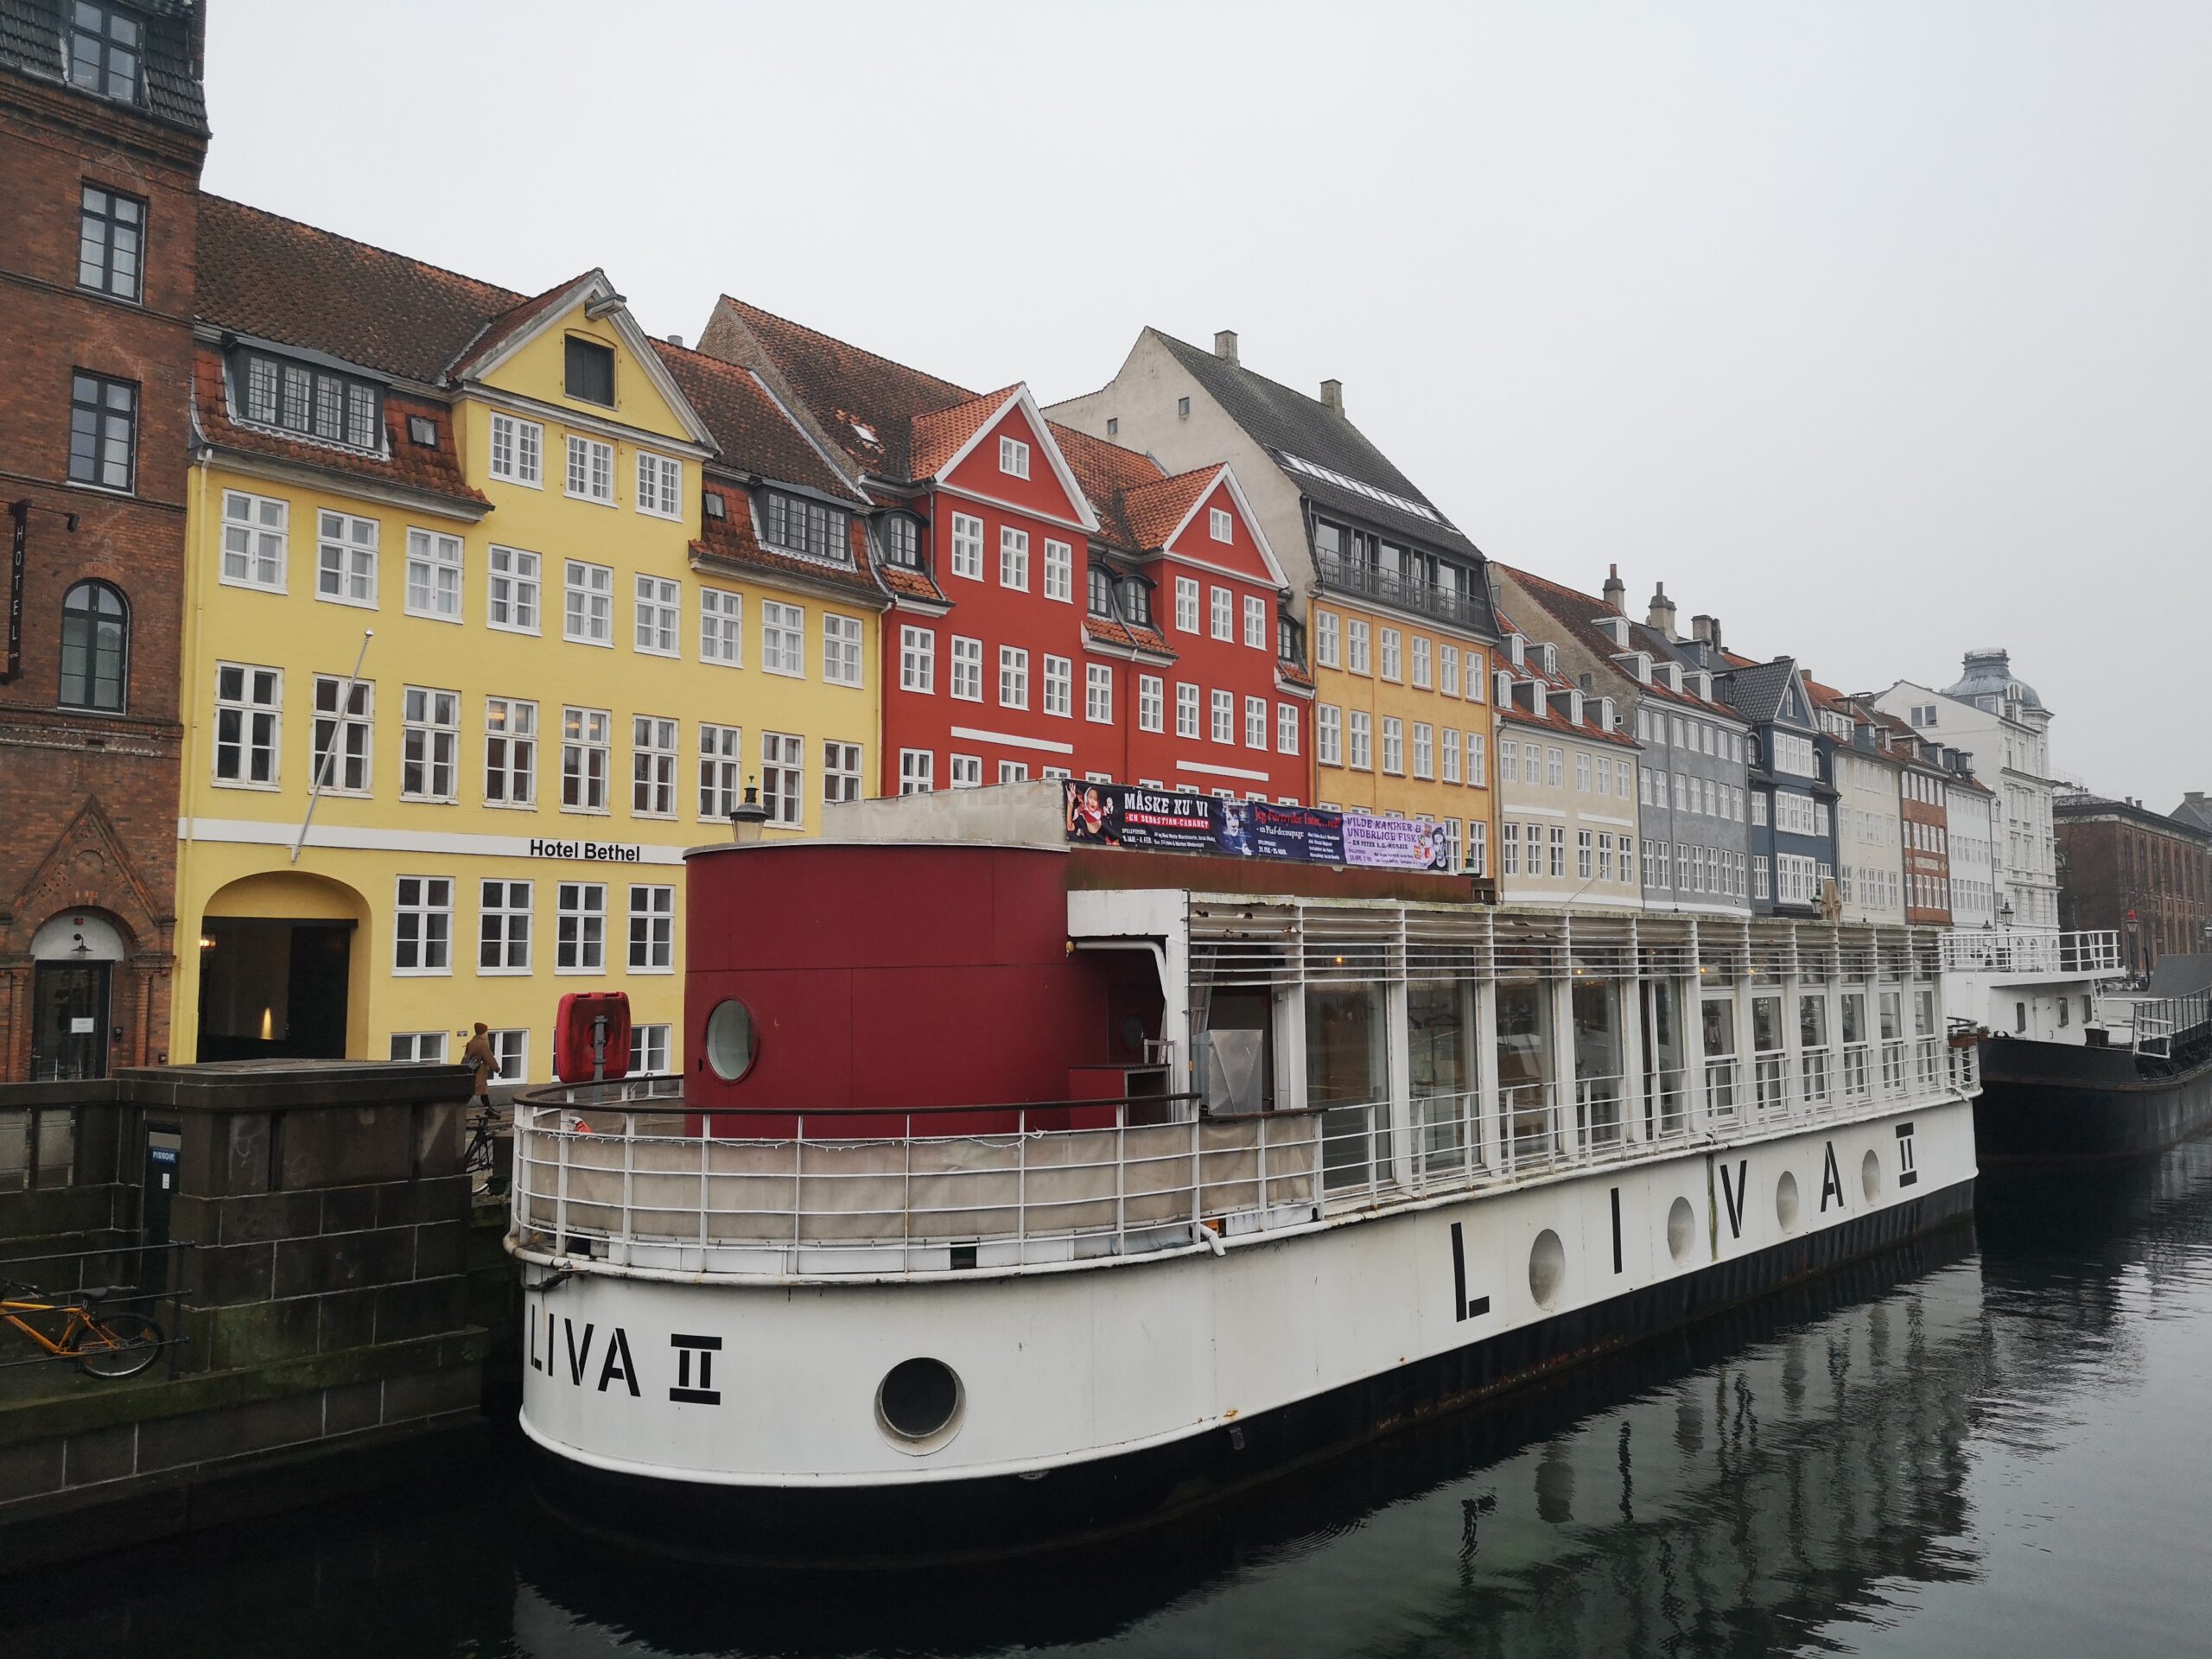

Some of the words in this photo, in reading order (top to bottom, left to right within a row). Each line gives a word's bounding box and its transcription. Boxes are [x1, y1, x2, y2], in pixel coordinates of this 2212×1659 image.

[11, 524, 24, 641] HOTEL
[1124, 791, 1169, 814] MÅSKE
[1196, 800, 1209, 817] VI
[1347, 817, 1373, 829] VILDE
[1347, 828, 1396, 841] UNDERLIGE
[1398, 832, 1417, 842] FISK
[530, 839, 578, 858] Hotel
[584, 842, 640, 861] Bethel
[152, 1150, 175, 1161] PISSOIR
[531, 1304, 641, 1397] LIVA
[669, 1333, 722, 1406] II
